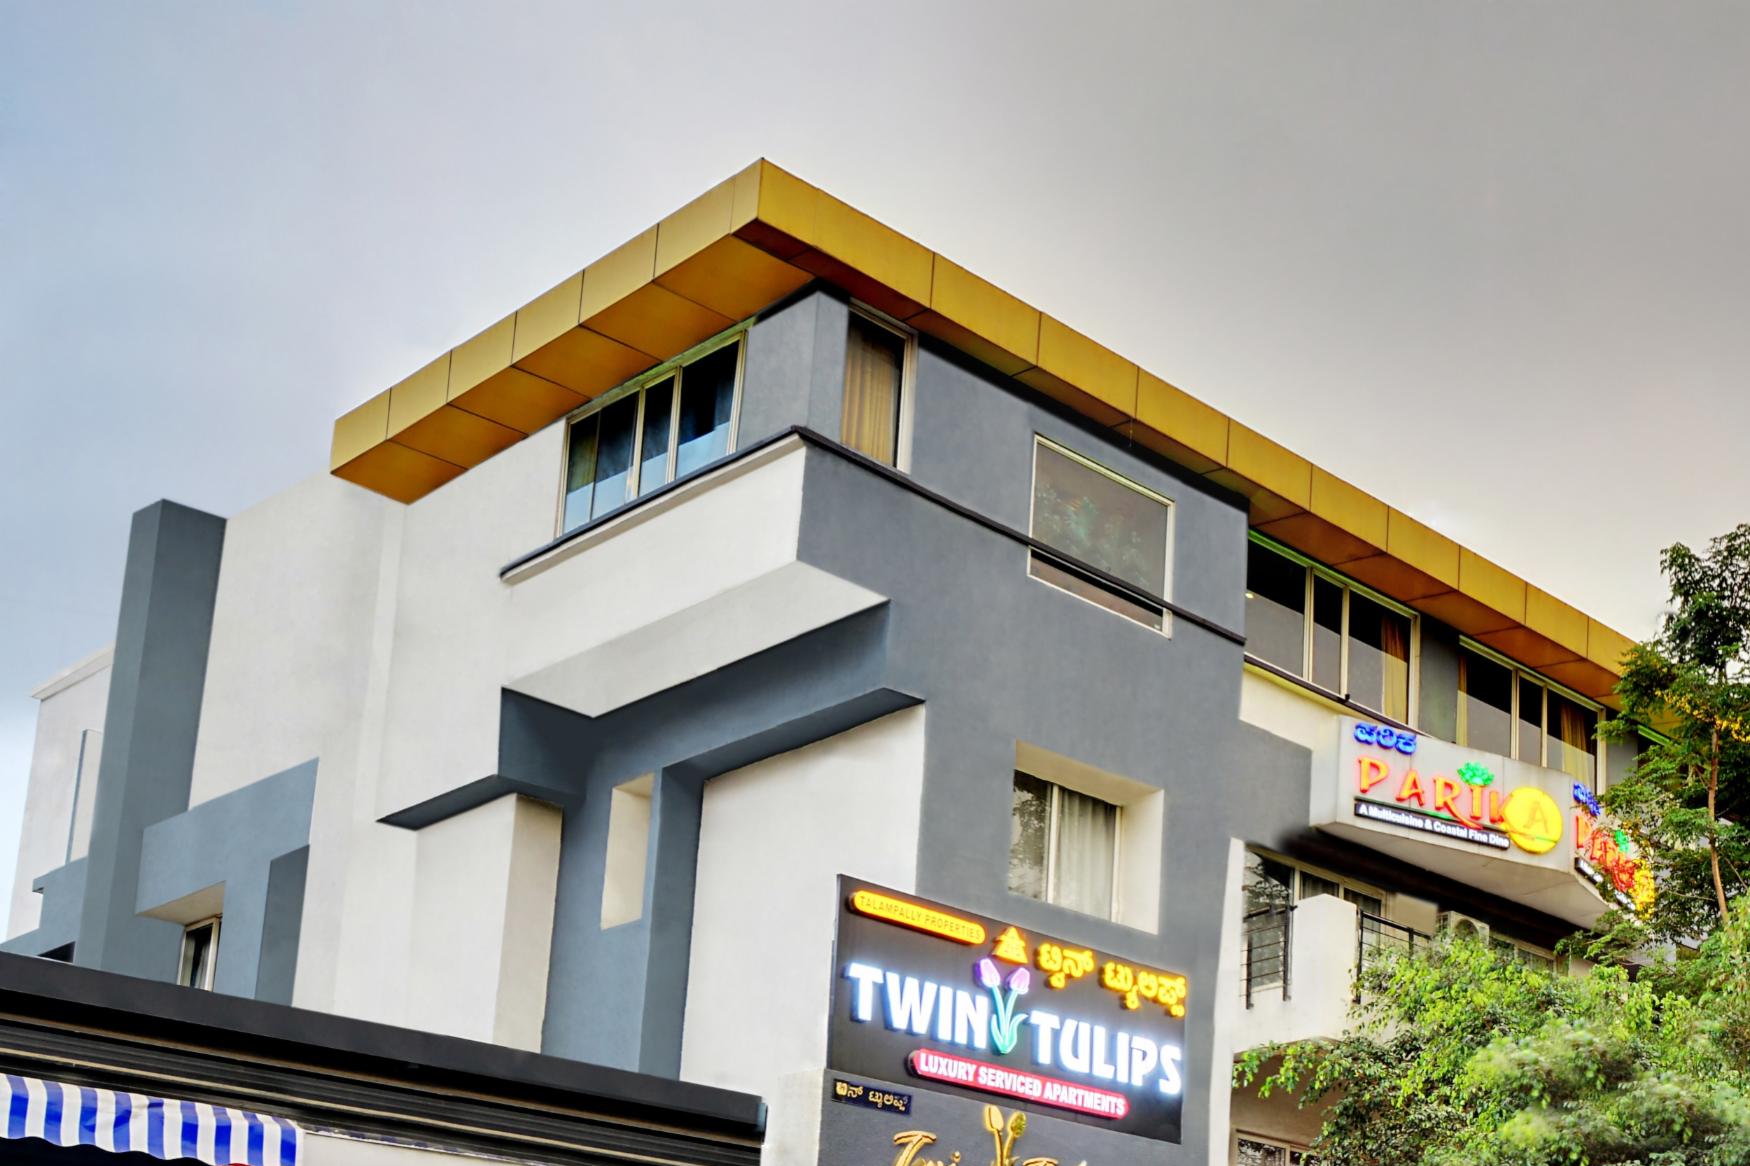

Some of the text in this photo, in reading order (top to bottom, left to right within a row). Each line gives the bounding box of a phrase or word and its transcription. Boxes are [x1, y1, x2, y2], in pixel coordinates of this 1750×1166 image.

[1359, 804, 1510, 849] A Multicuisine & Coastal Fine Dine
[860, 895, 981, 940] TALAMPALLY PROPERTIES
[847, 962, 1183, 1096] TWIN TULIPS
[919, 1052, 1126, 1116] LUXURY SERVICED APARTMENTS
